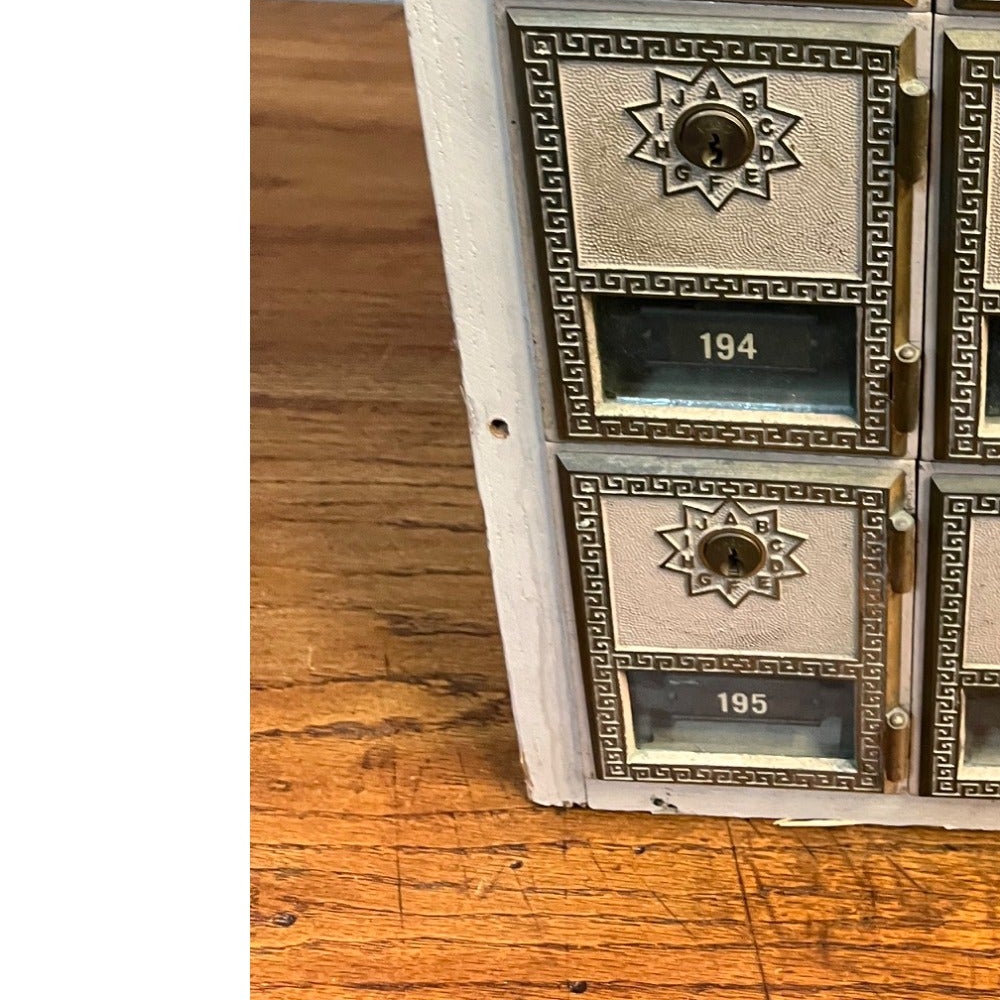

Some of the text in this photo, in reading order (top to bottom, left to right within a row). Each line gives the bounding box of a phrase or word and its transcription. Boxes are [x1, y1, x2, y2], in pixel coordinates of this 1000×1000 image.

[671, 88, 685, 107] J
[705, 80, 722, 100] A
[742, 89, 758, 111] B
[760, 117, 774, 135] C
[653, 138, 670, 158] H
[760, 141, 774, 163] D
[675, 165, 691, 181] G
[745, 164, 760, 185] E
[709, 175, 724, 193] F
[699, 332, 758, 361] 194
[717, 692, 768, 715] 195
